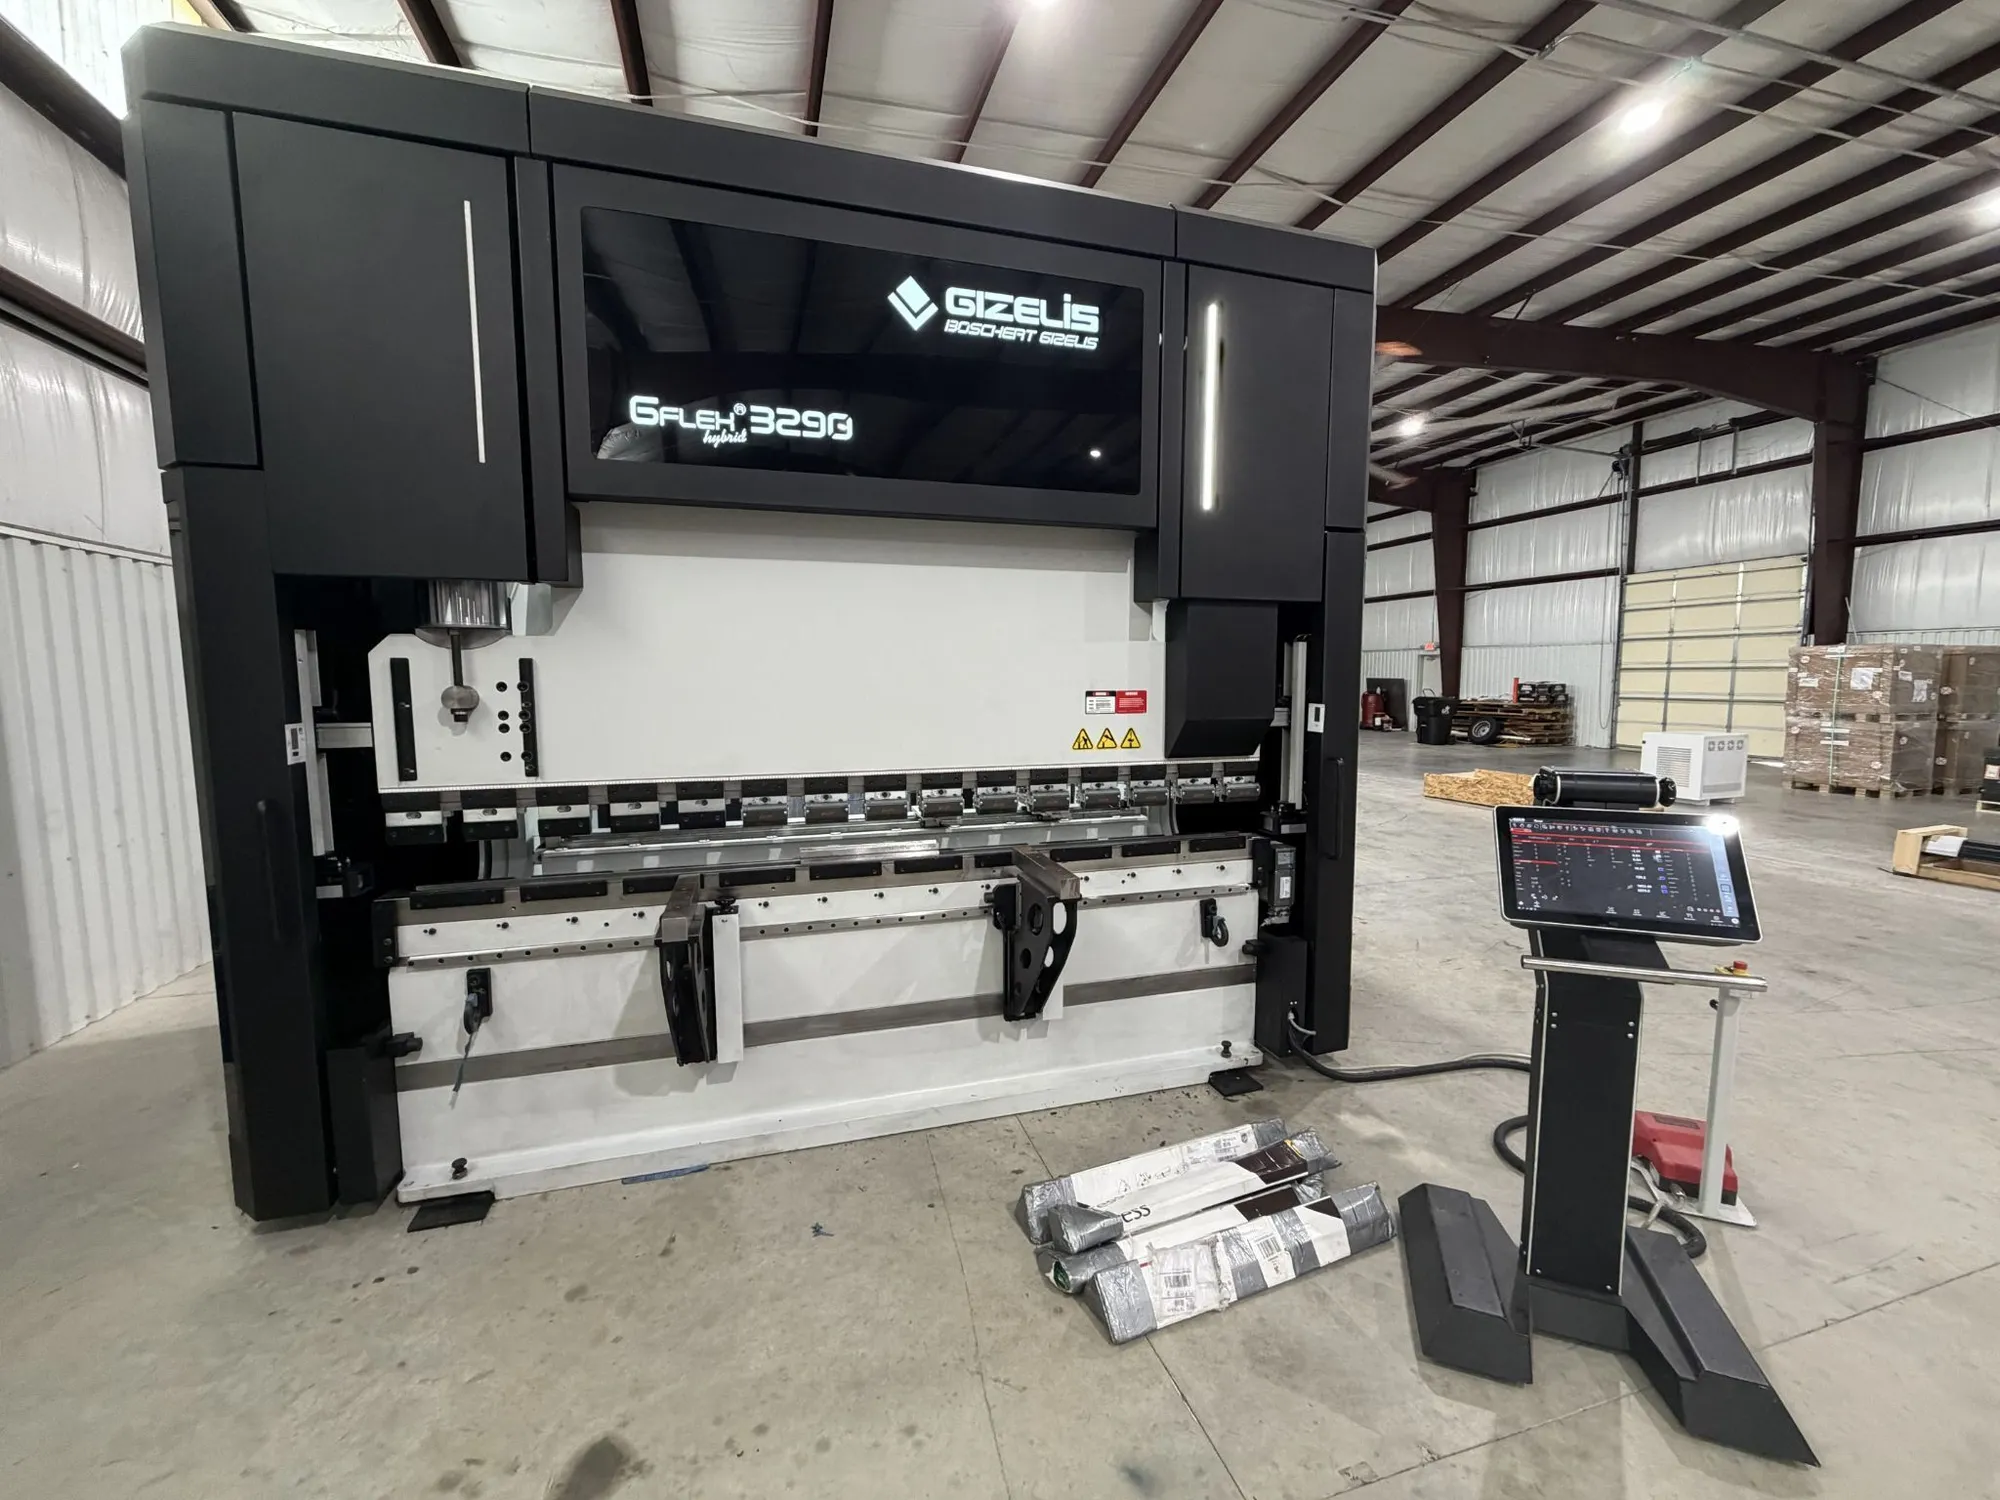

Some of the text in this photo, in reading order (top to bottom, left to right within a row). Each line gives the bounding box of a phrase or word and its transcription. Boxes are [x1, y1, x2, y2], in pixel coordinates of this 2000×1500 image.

[944, 318, 1099, 350] BOSCHERT GIZELIS
[702, 427, 748, 448] hybrid
